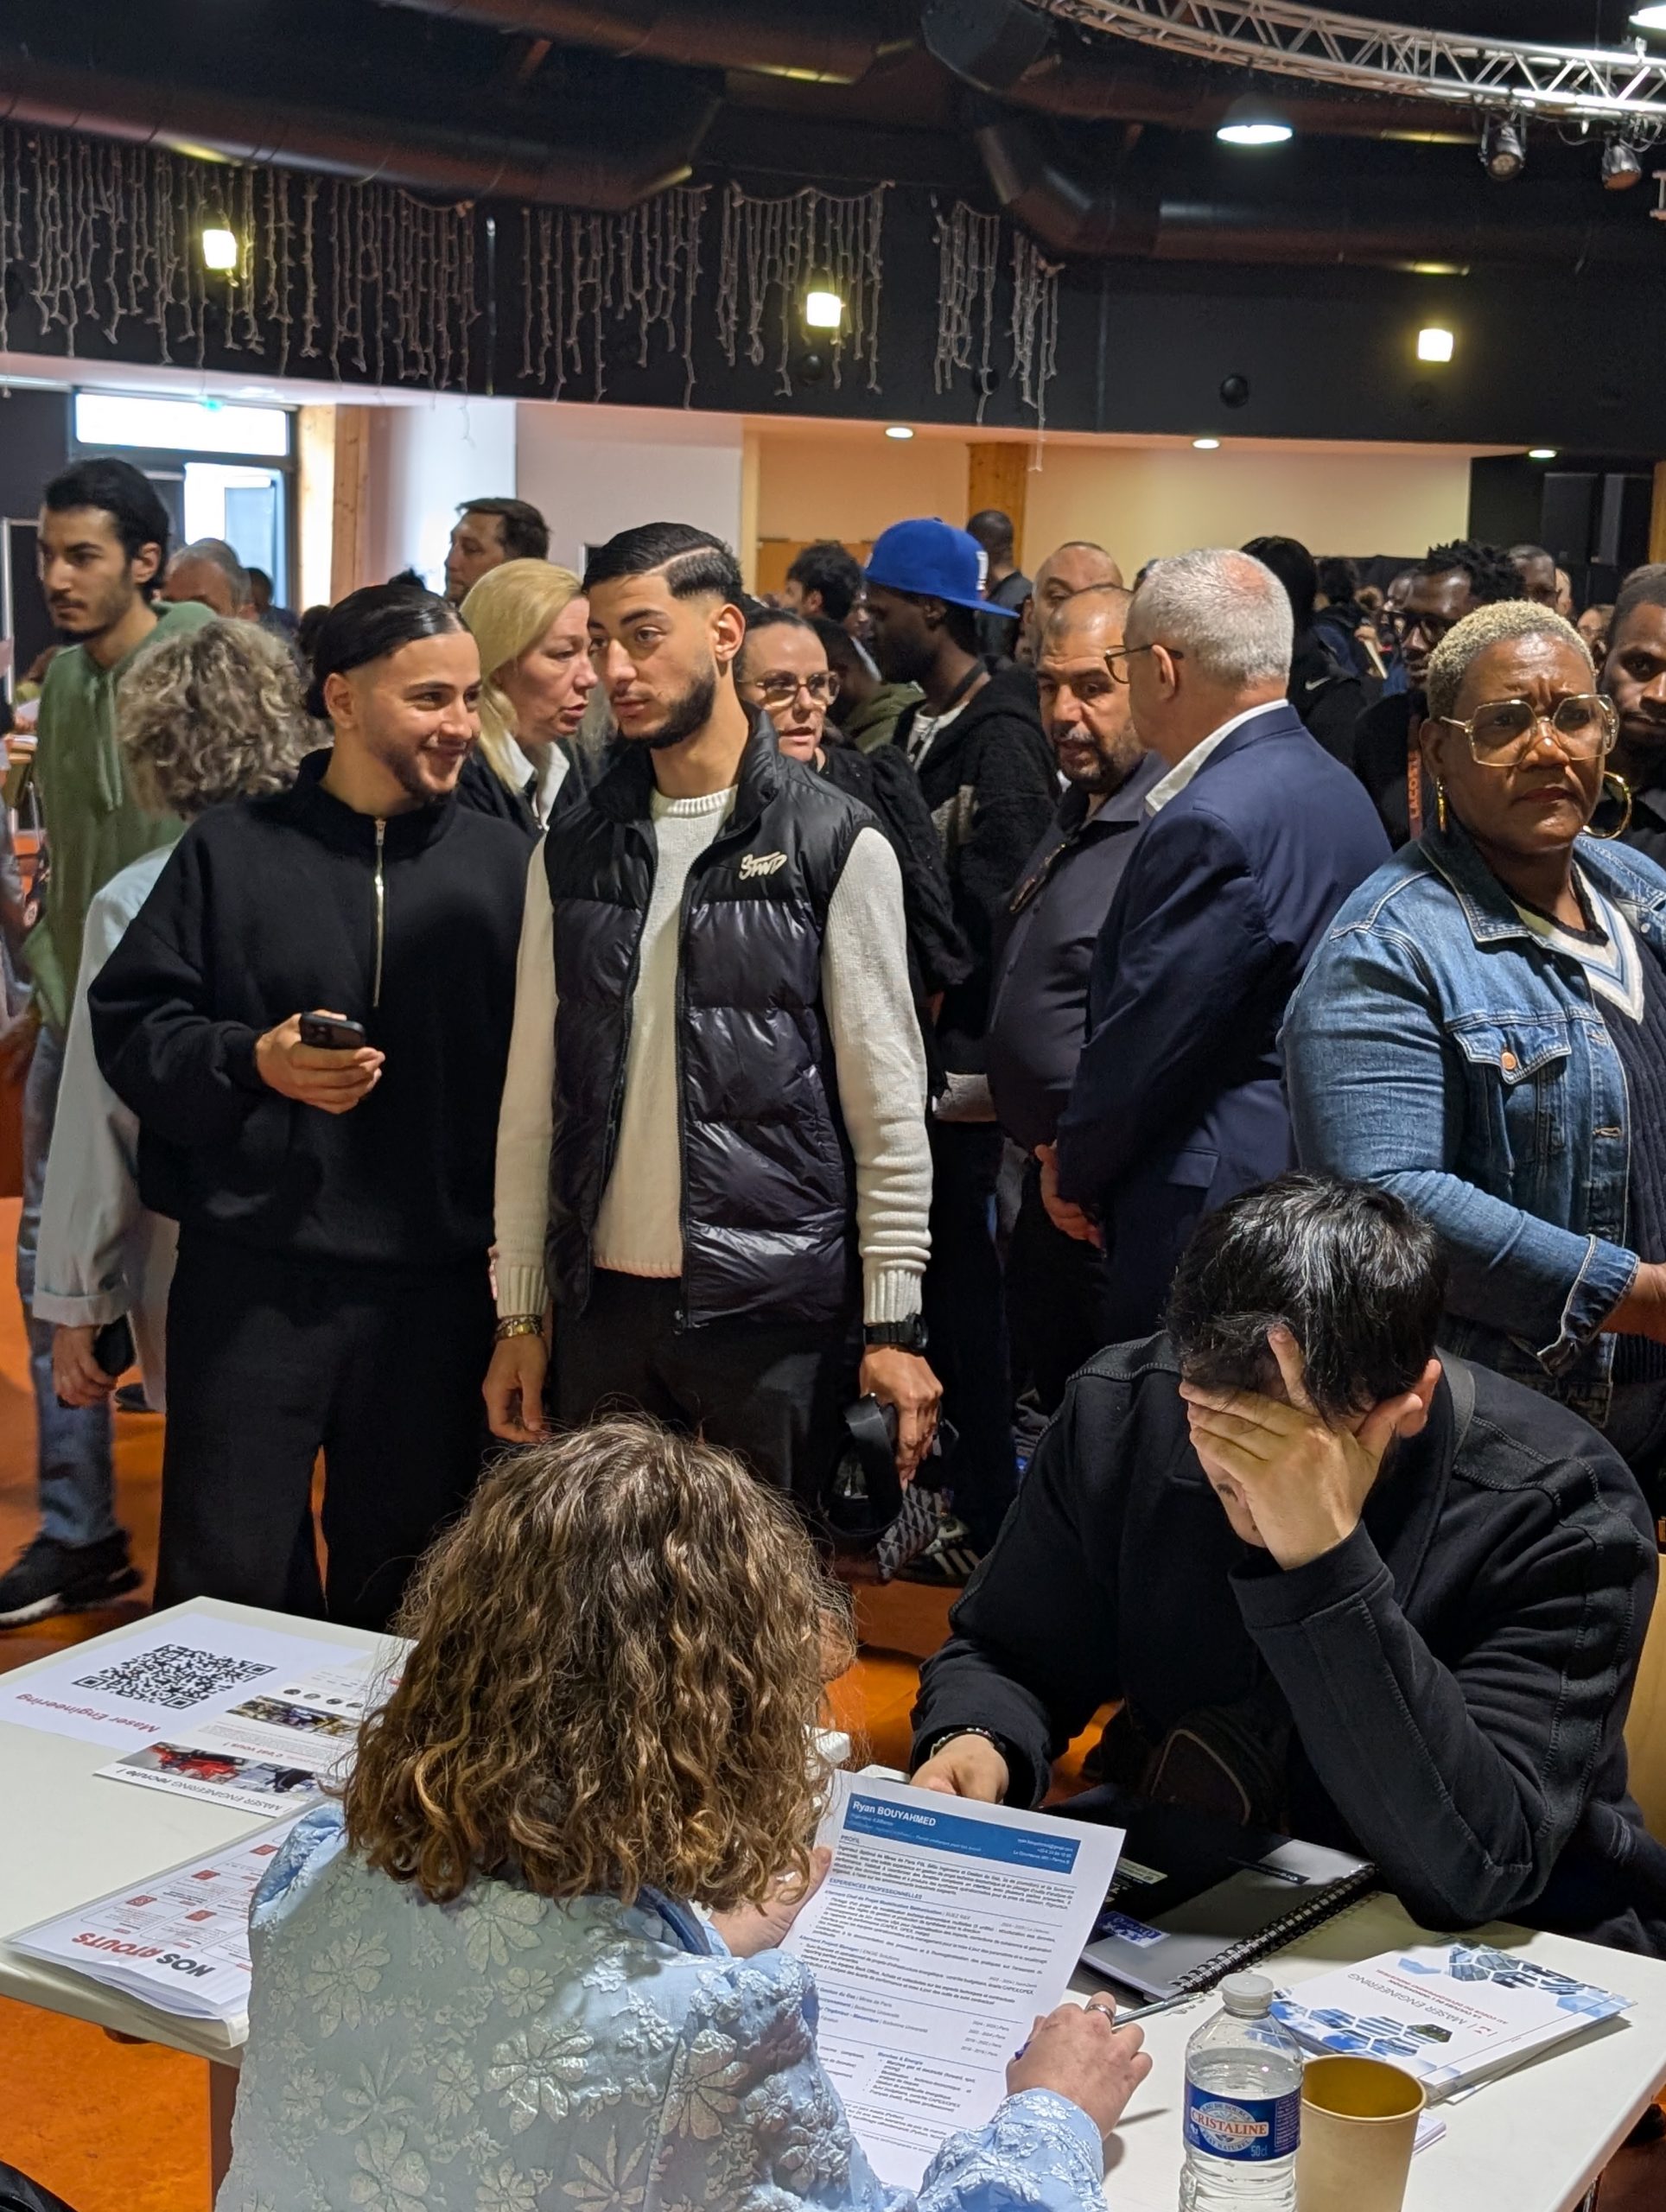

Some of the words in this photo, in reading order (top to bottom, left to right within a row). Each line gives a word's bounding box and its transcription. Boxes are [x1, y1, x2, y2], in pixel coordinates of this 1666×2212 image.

[16, 1694, 109, 1720] Engineering
[109, 1716, 161, 1732] Maser
[852, 1801, 875, 1817] Ryan
[876, 1805, 937, 1827] BOUYAHMED
[72, 1932, 164, 1958] ATOUTS
[156, 1953, 216, 1977] NOS
[1348, 1974, 1426, 2008] ENGINEERING
[1425, 2005, 1467, 2025] MASER
[1192, 2110, 1267, 2134] CRISTALINE
[1250, 2145, 1268, 2158] 50cl
